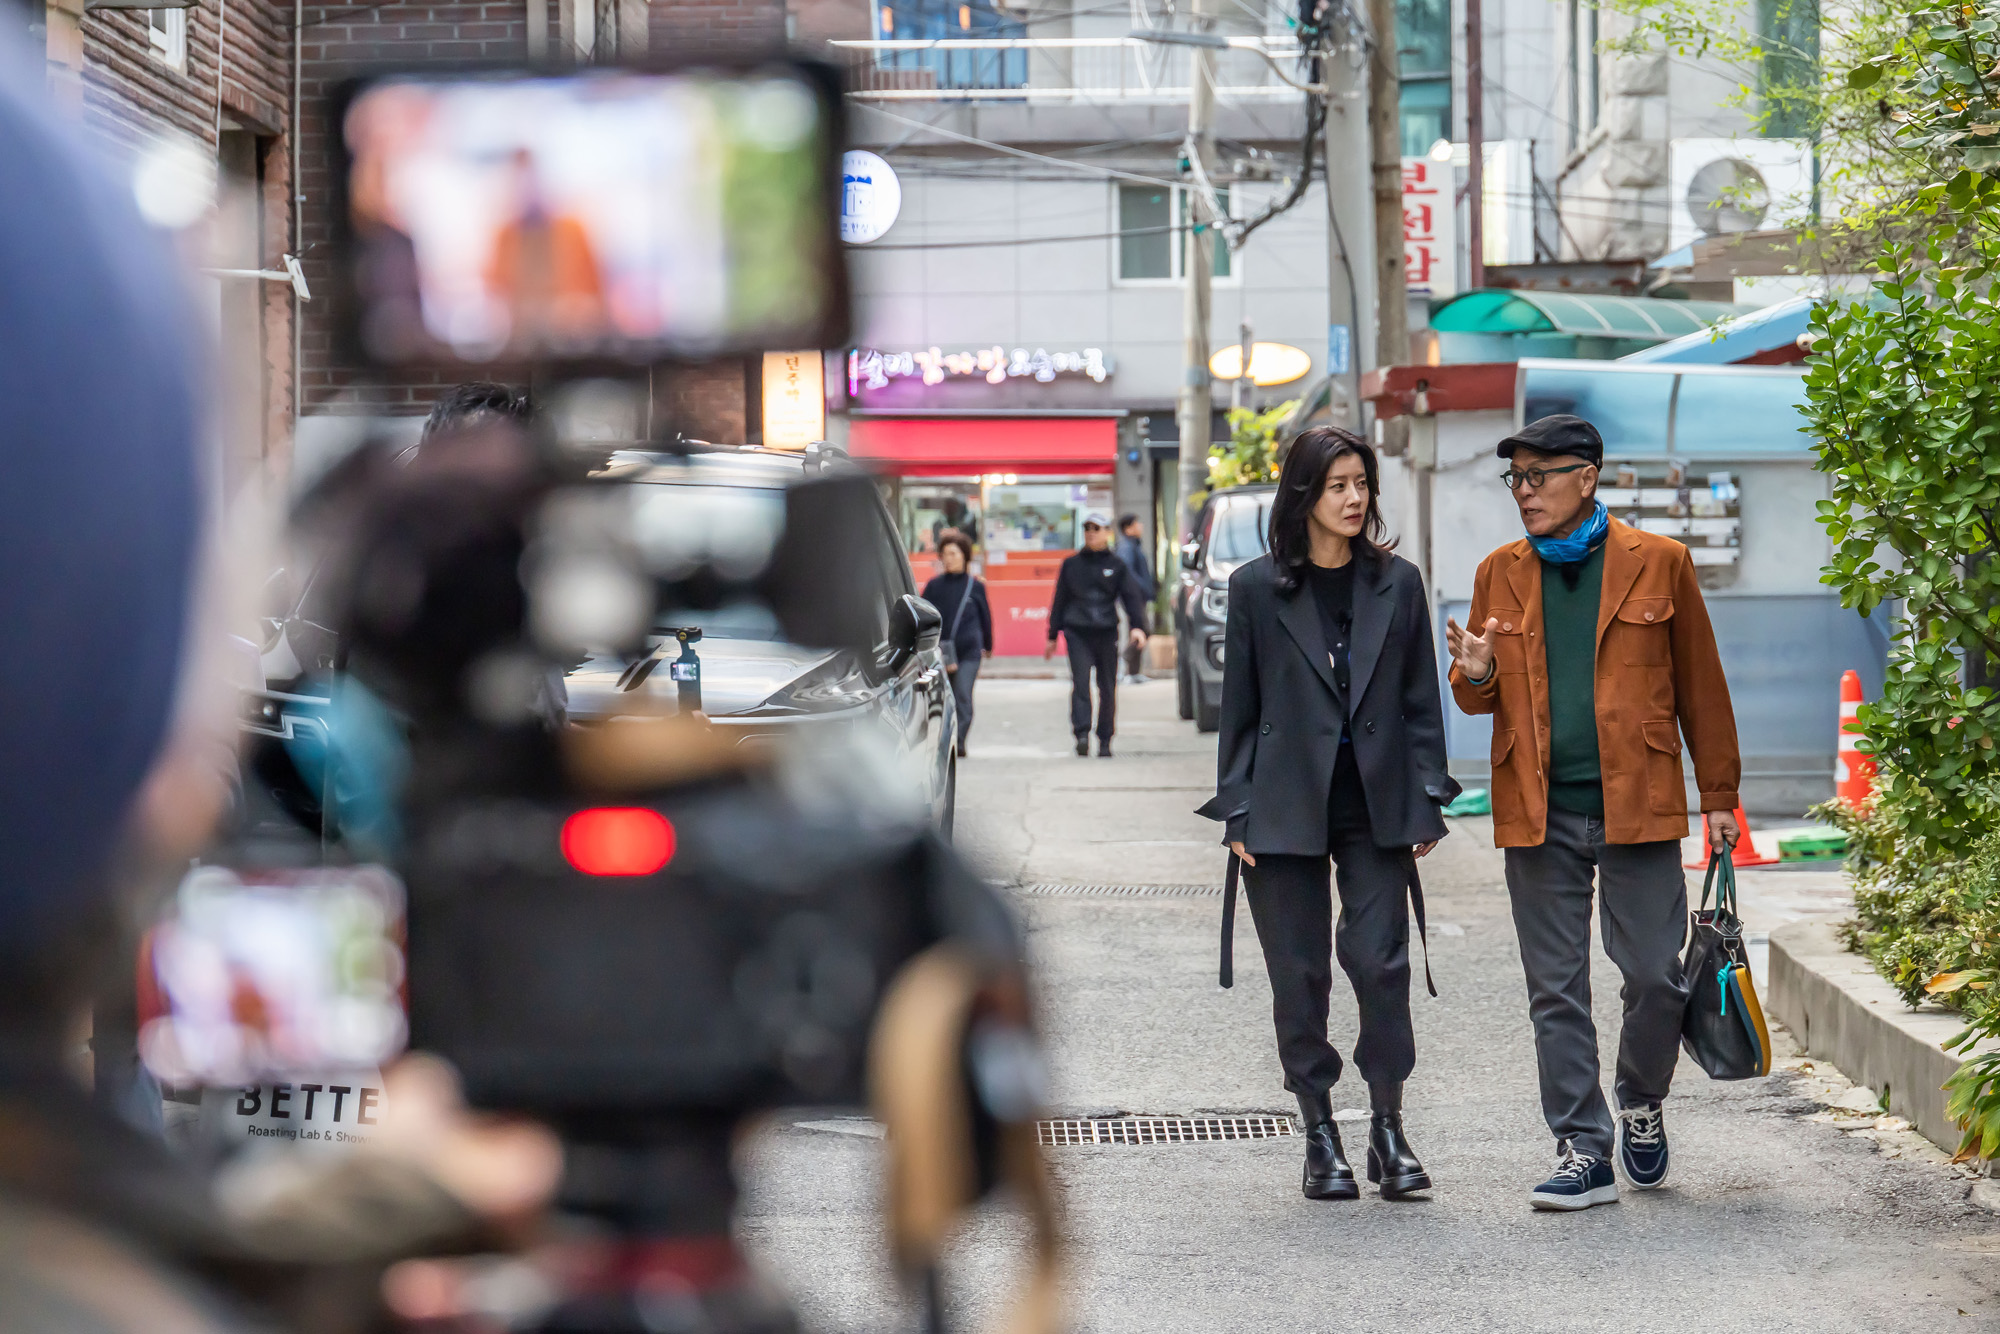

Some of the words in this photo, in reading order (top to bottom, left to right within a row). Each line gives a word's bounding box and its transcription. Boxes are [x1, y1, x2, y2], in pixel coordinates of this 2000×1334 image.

[248, 1124, 296, 1141] Roasting
[300, 1128, 320, 1140] Lab
[324, 1130, 332, 1141] &
[336, 1131, 373, 1144] Show
